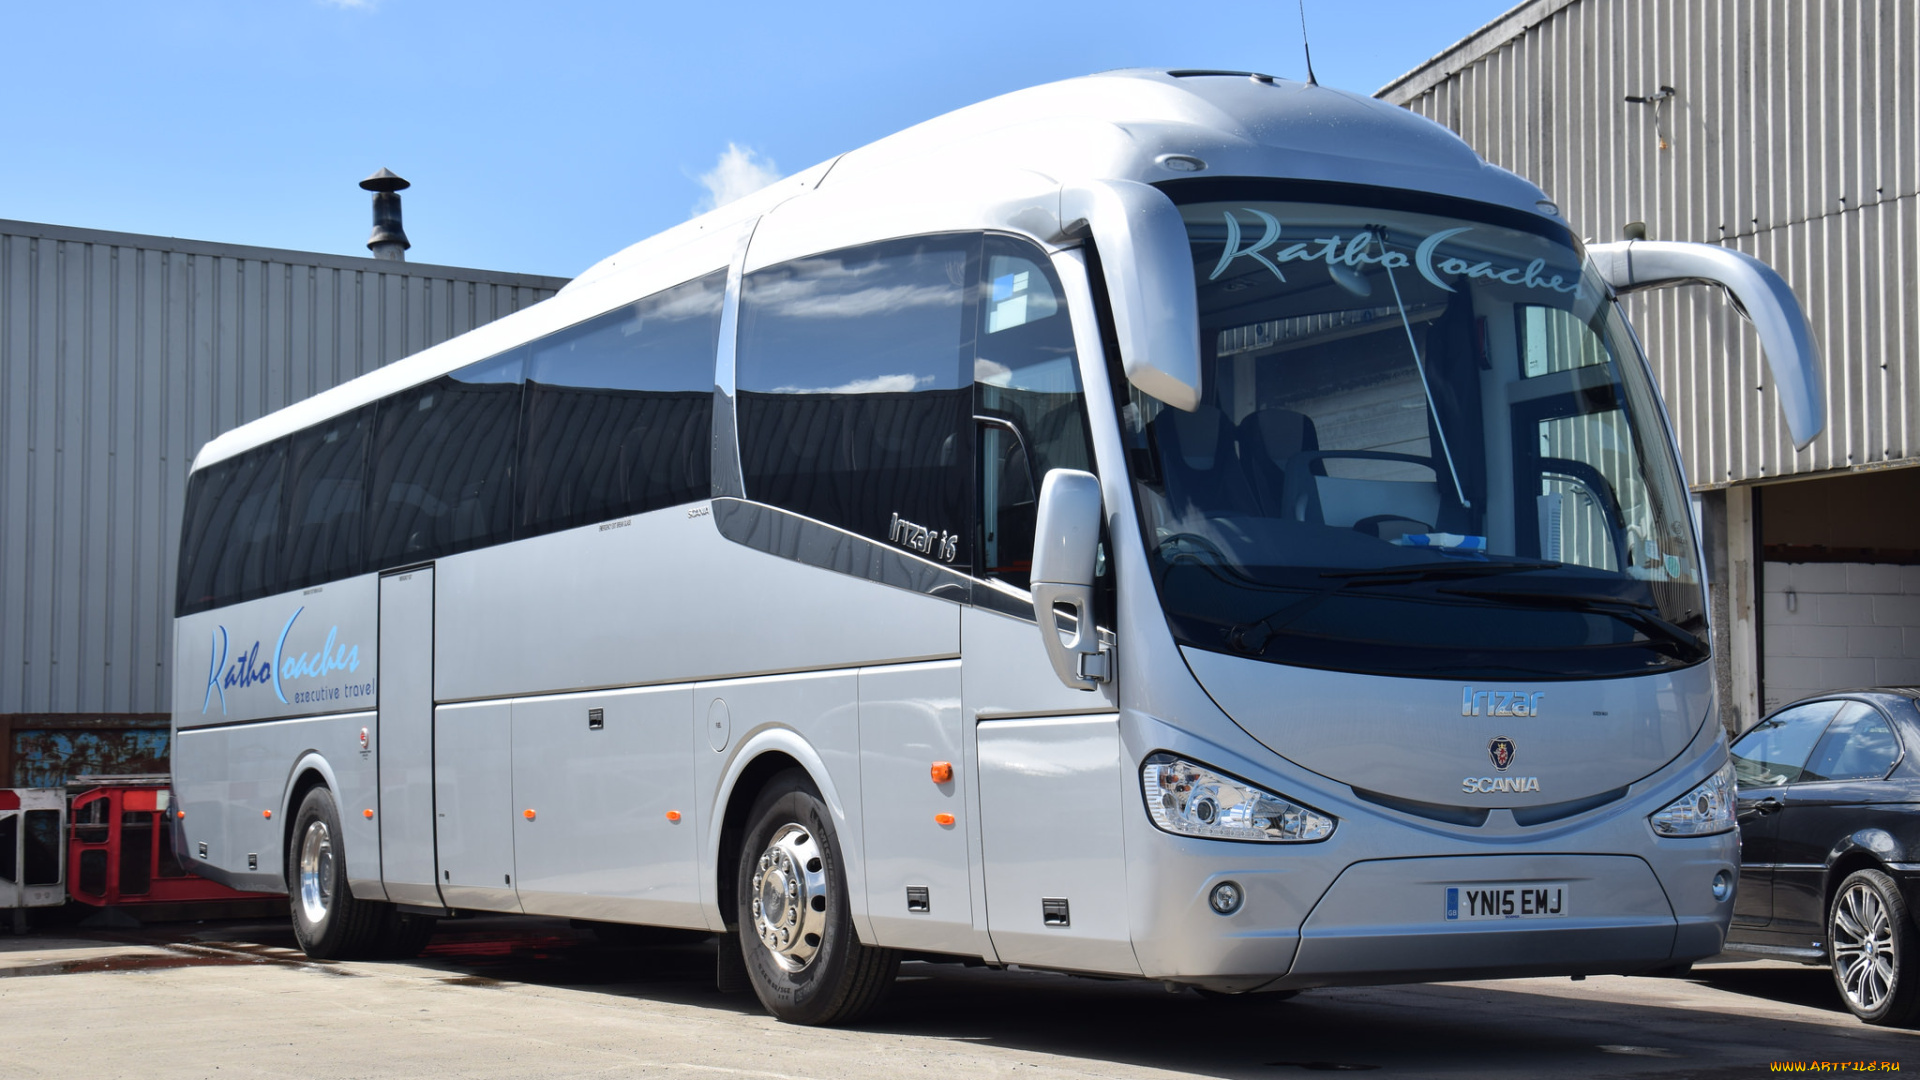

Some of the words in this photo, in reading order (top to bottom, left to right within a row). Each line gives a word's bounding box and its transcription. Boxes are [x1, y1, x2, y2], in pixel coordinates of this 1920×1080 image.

[1208, 208, 1409, 283] Ratho
[1415, 227, 1586, 300] Coaches
[888, 512, 938, 554] Irizar
[938, 529, 958, 562] i6
[202, 625, 271, 715] Ratho
[273, 605, 360, 705] Coaches
[294, 685, 340, 704] executive
[344, 677, 375, 699] travel
[1462, 685, 1545, 717] Irizar
[1462, 776, 1540, 793] SCANIA
[1466, 889, 1514, 916] YN15
[1521, 889, 1562, 915] EMJ
